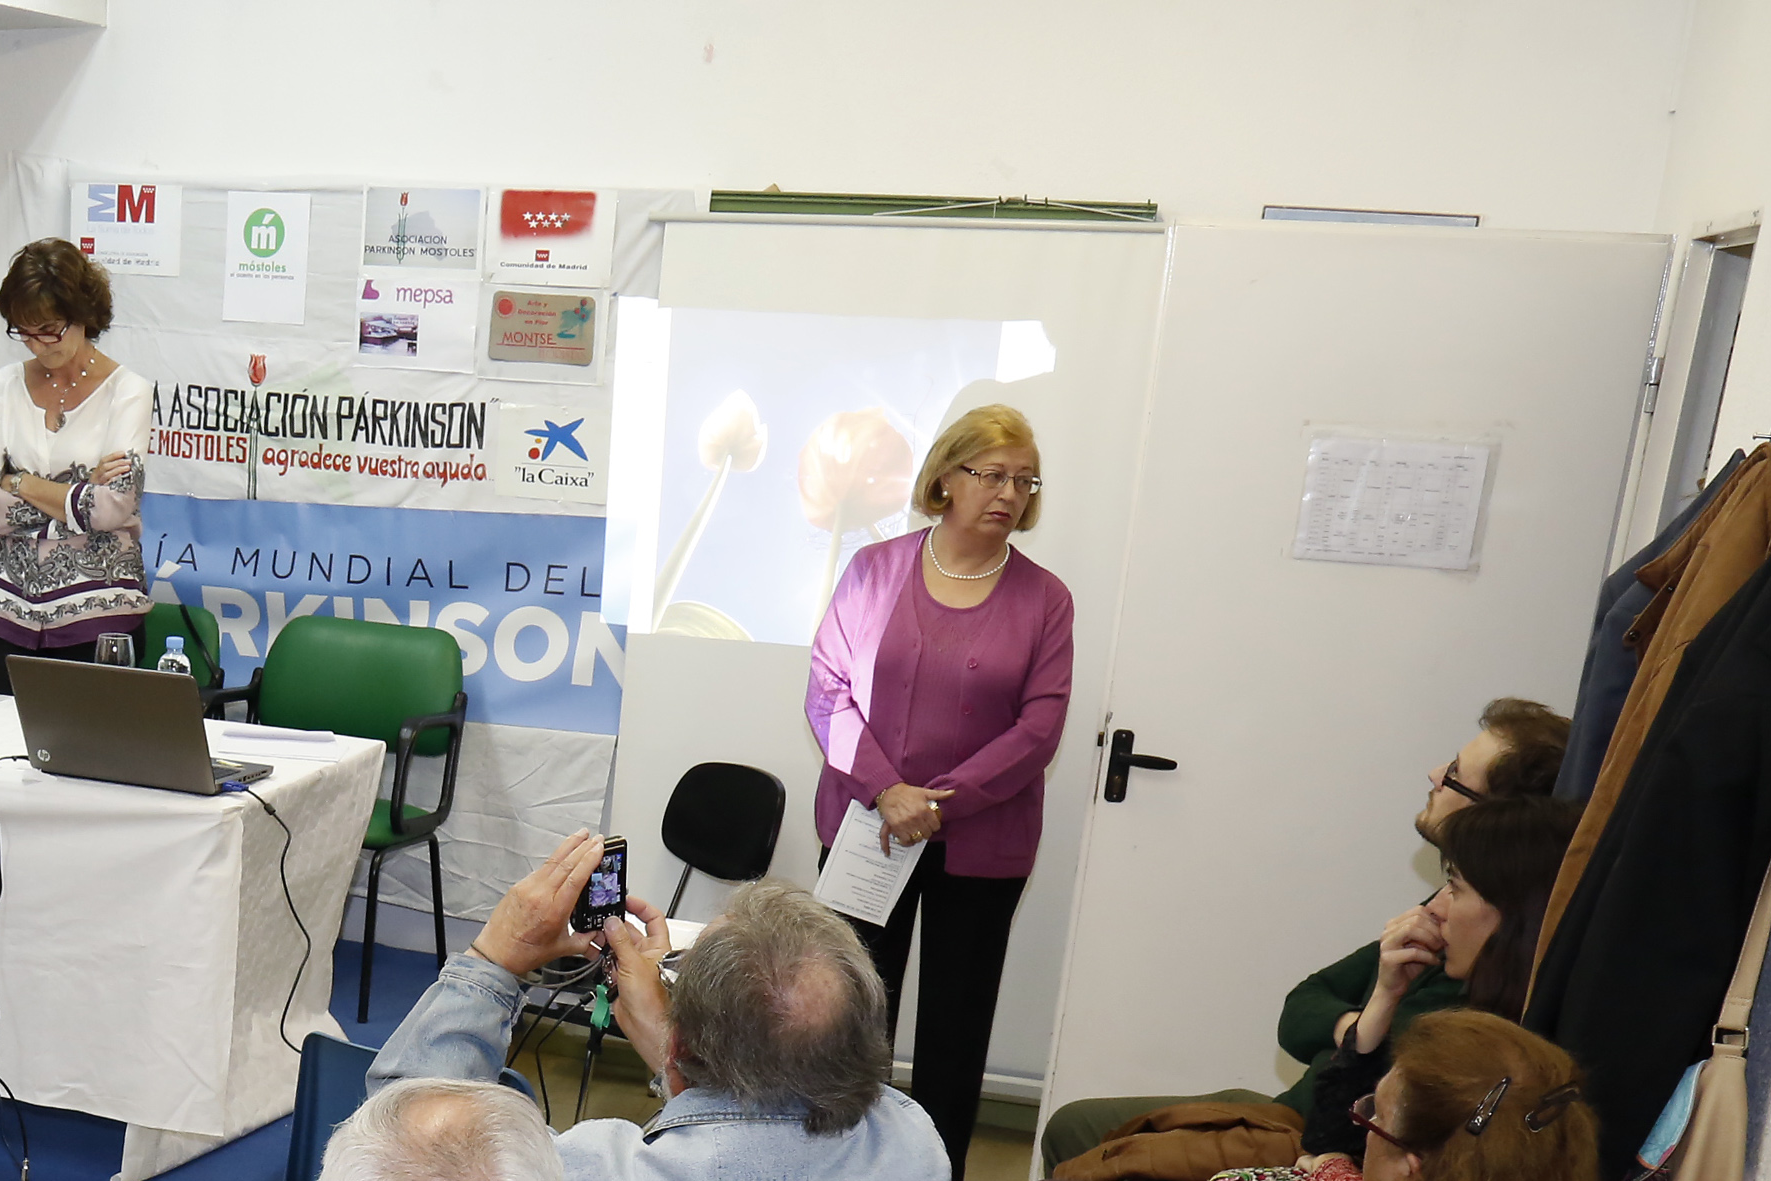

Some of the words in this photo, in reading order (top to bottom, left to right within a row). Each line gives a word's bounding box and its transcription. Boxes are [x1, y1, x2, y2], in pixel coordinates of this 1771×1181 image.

[388, 234, 448, 245] ASOCIACION
[364, 245, 416, 256] PARKINSON
[238, 260, 287, 273] móstoles
[500, 261, 545, 270] Comunidad
[396, 286, 454, 309] mepsa
[501, 331, 557, 347] MONTSE
[168, 382, 329, 440] ASOCIACIÓN
[262, 443, 352, 476] agradece
[356, 454, 420, 480] vuestra
[154, 533, 199, 572] ÍA
[231, 547, 469, 590] MUNDIAL
[504, 562, 601, 598] DEL
